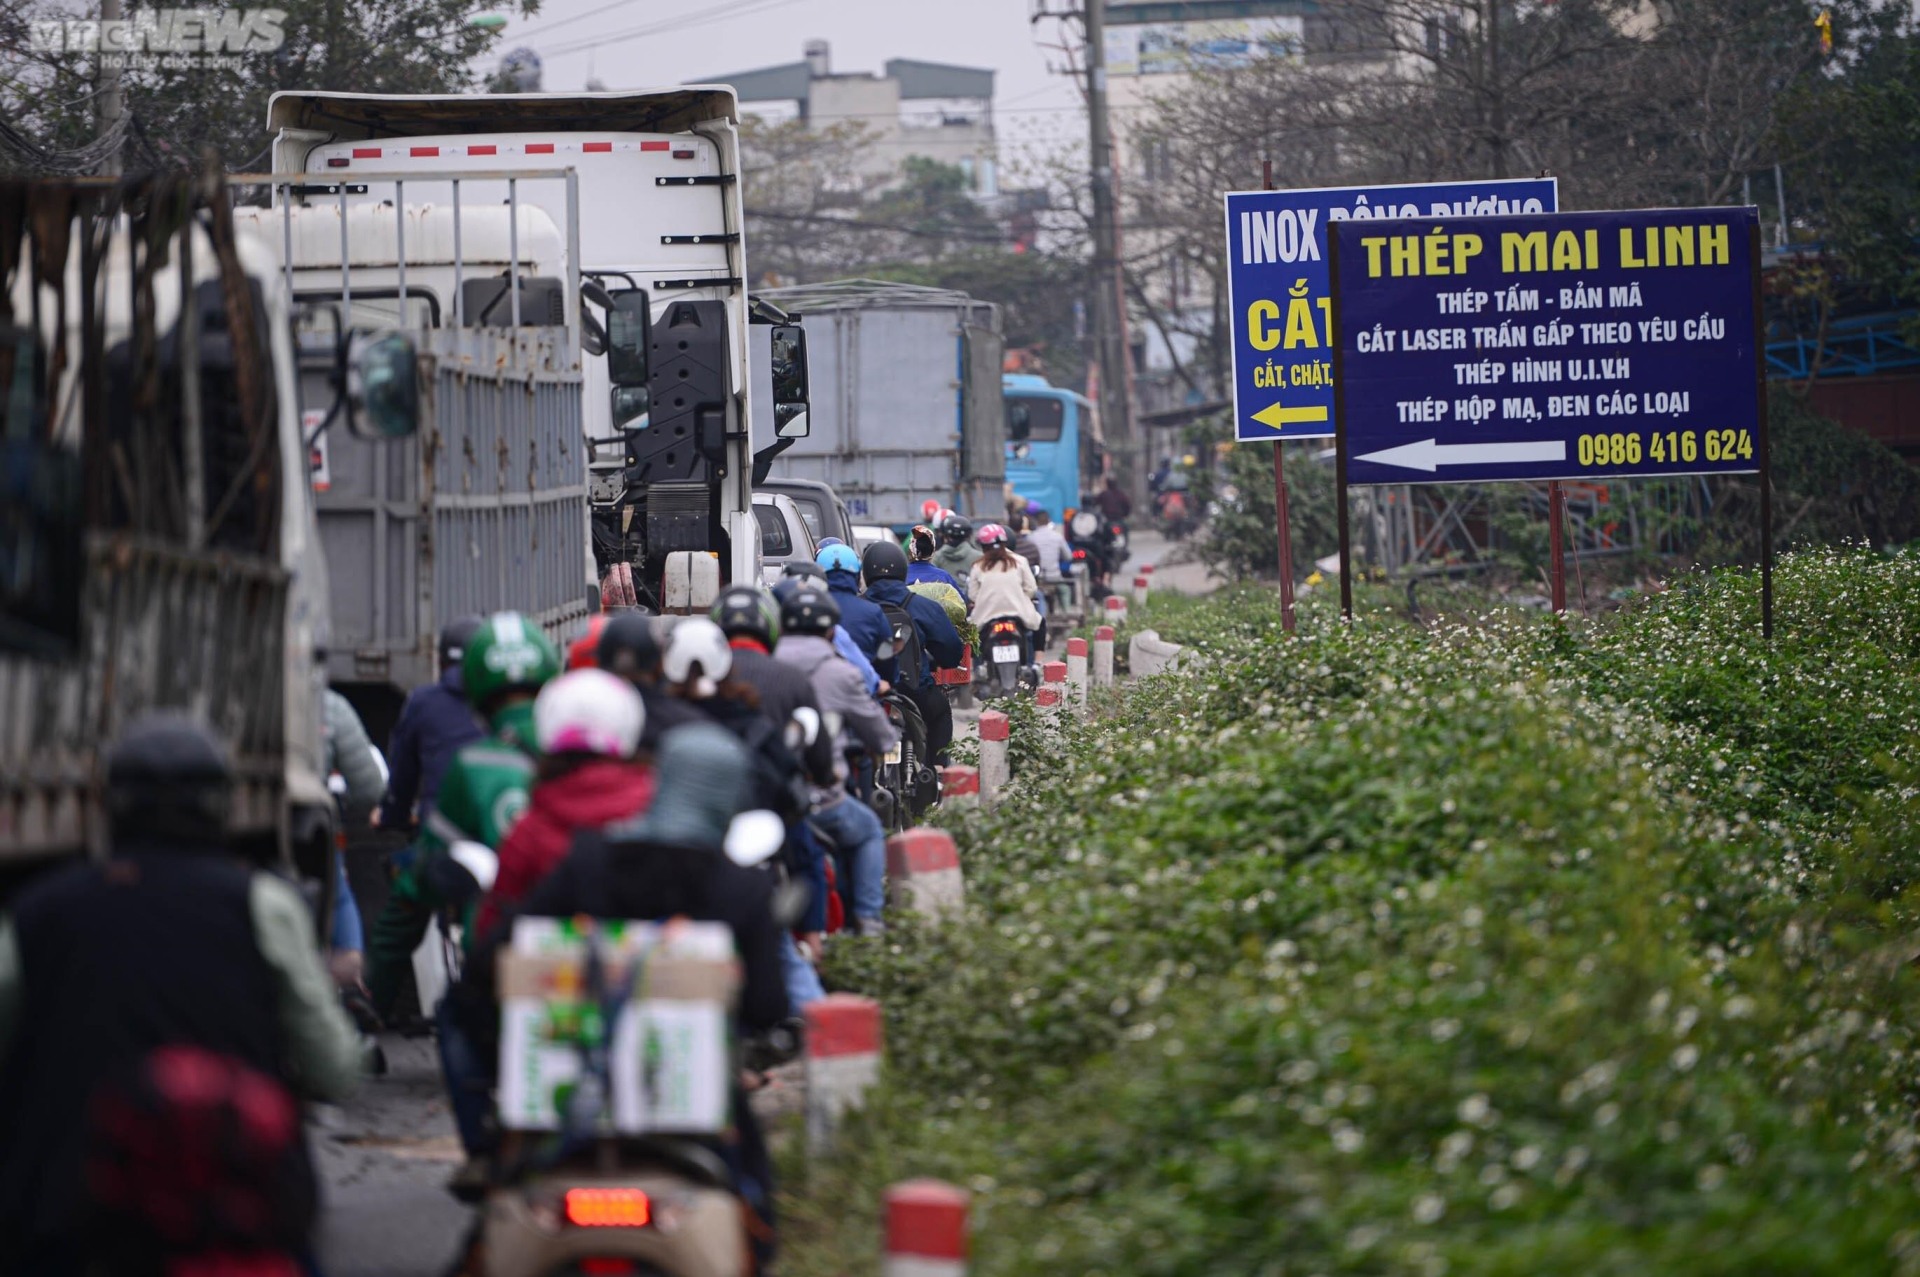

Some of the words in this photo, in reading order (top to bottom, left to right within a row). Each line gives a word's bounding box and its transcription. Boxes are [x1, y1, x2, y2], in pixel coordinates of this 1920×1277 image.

[1241, 208, 1321, 265] INOX
[1361, 226, 1483, 278] THÉP
[1501, 229, 1599, 273] MAI
[1619, 224, 1730, 268] LINH
[1436, 287, 1488, 314] THÉP
[1494, 283, 1539, 312] TẤM
[1559, 281, 1603, 310] BẢN
[1609, 281, 1643, 308] MÃ
[1357, 323, 1396, 352] CẮT
[1402, 328, 1466, 351] LASER
[1472, 319, 1526, 348] TRẤN
[1533, 317, 1575, 347] GẤP
[1580, 321, 1632, 345] THEO
[1638, 316, 1677, 342] YÊU
[1253, 357, 1287, 389] CẮT,
[1454, 358, 1506, 385] THÉP
[1512, 357, 1562, 383] HÌNH
[1396, 396, 1448, 423] THÉP
[1455, 394, 1496, 425] HỘP
[1503, 397, 1542, 423] MẠ,
[1547, 395, 1590, 417] ĐEN
[1596, 389, 1638, 416] CÁC
[1644, 391, 1690, 418] LOẠI
[1578, 432, 1642, 466] 0986
[1649, 430, 1697, 463] 416
[1705, 429, 1753, 462] 624
